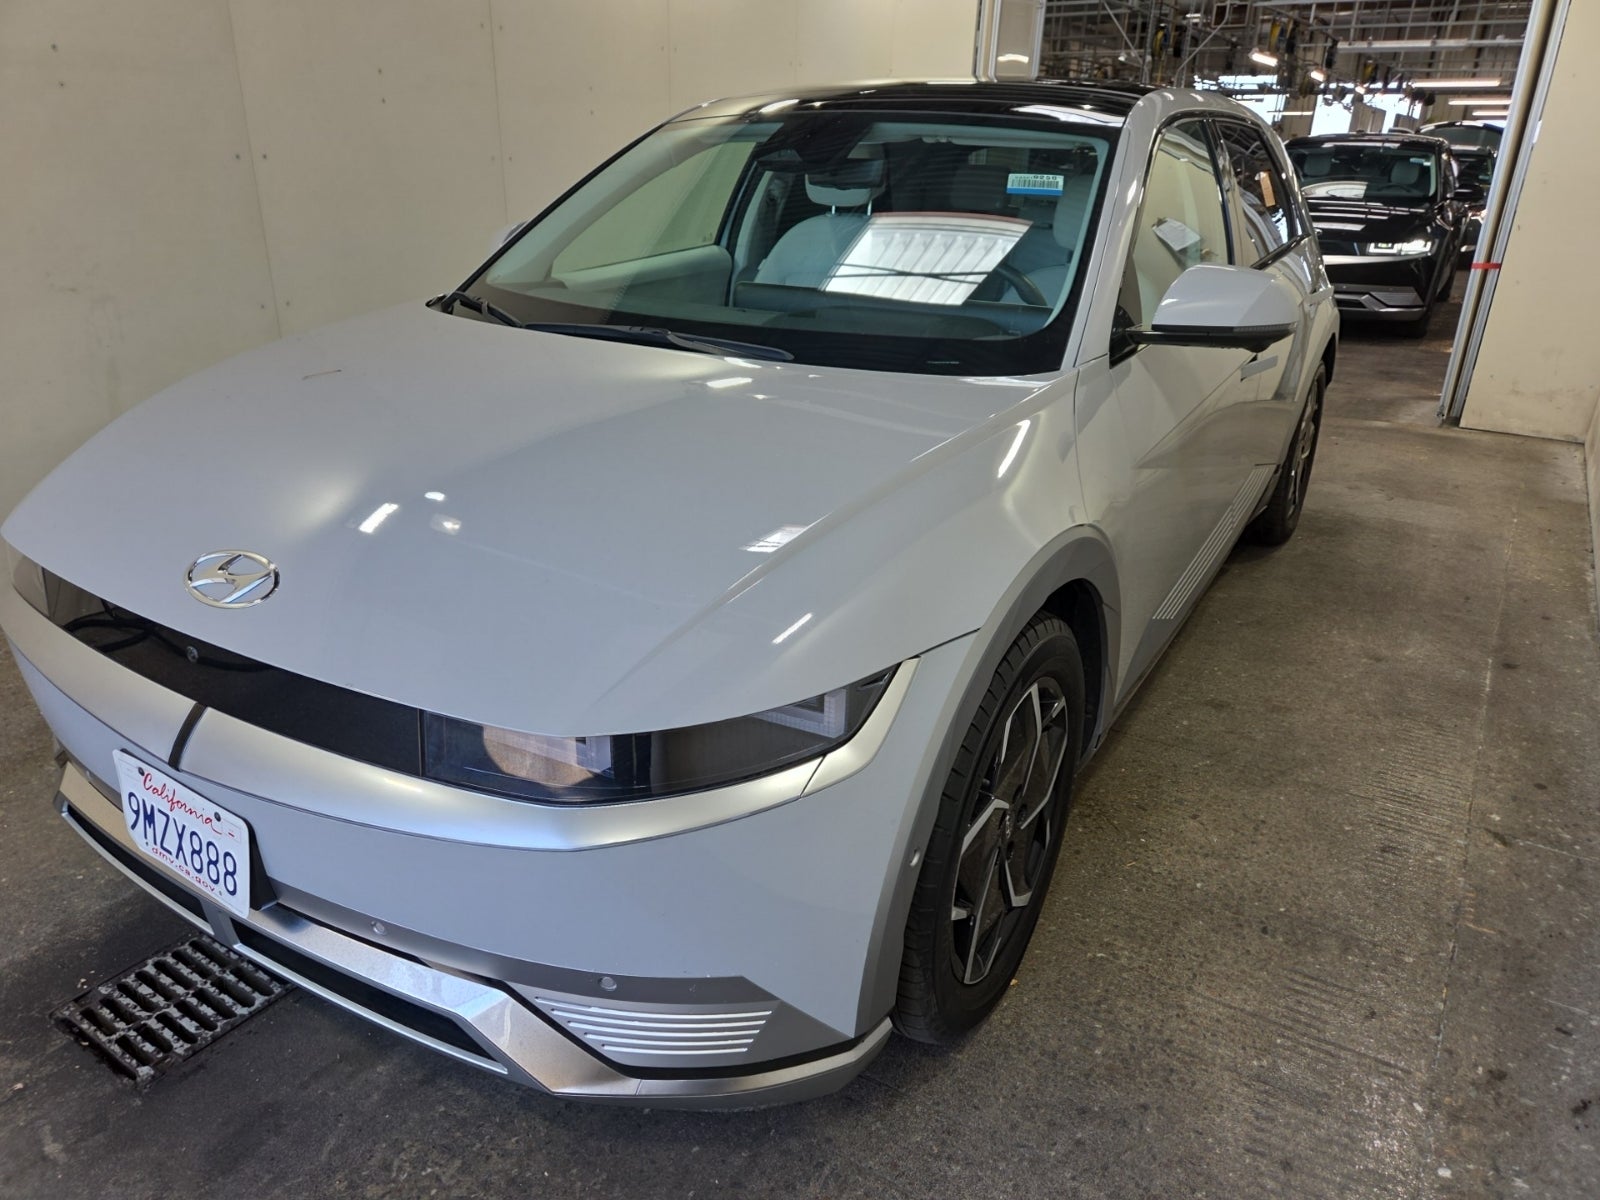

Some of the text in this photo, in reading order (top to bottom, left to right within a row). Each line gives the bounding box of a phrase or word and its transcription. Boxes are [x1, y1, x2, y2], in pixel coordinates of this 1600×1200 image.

[143, 772, 222, 835] California
[128, 791, 237, 896] 9MZX888
[152, 847, 215, 892] dmv.ca.gov
